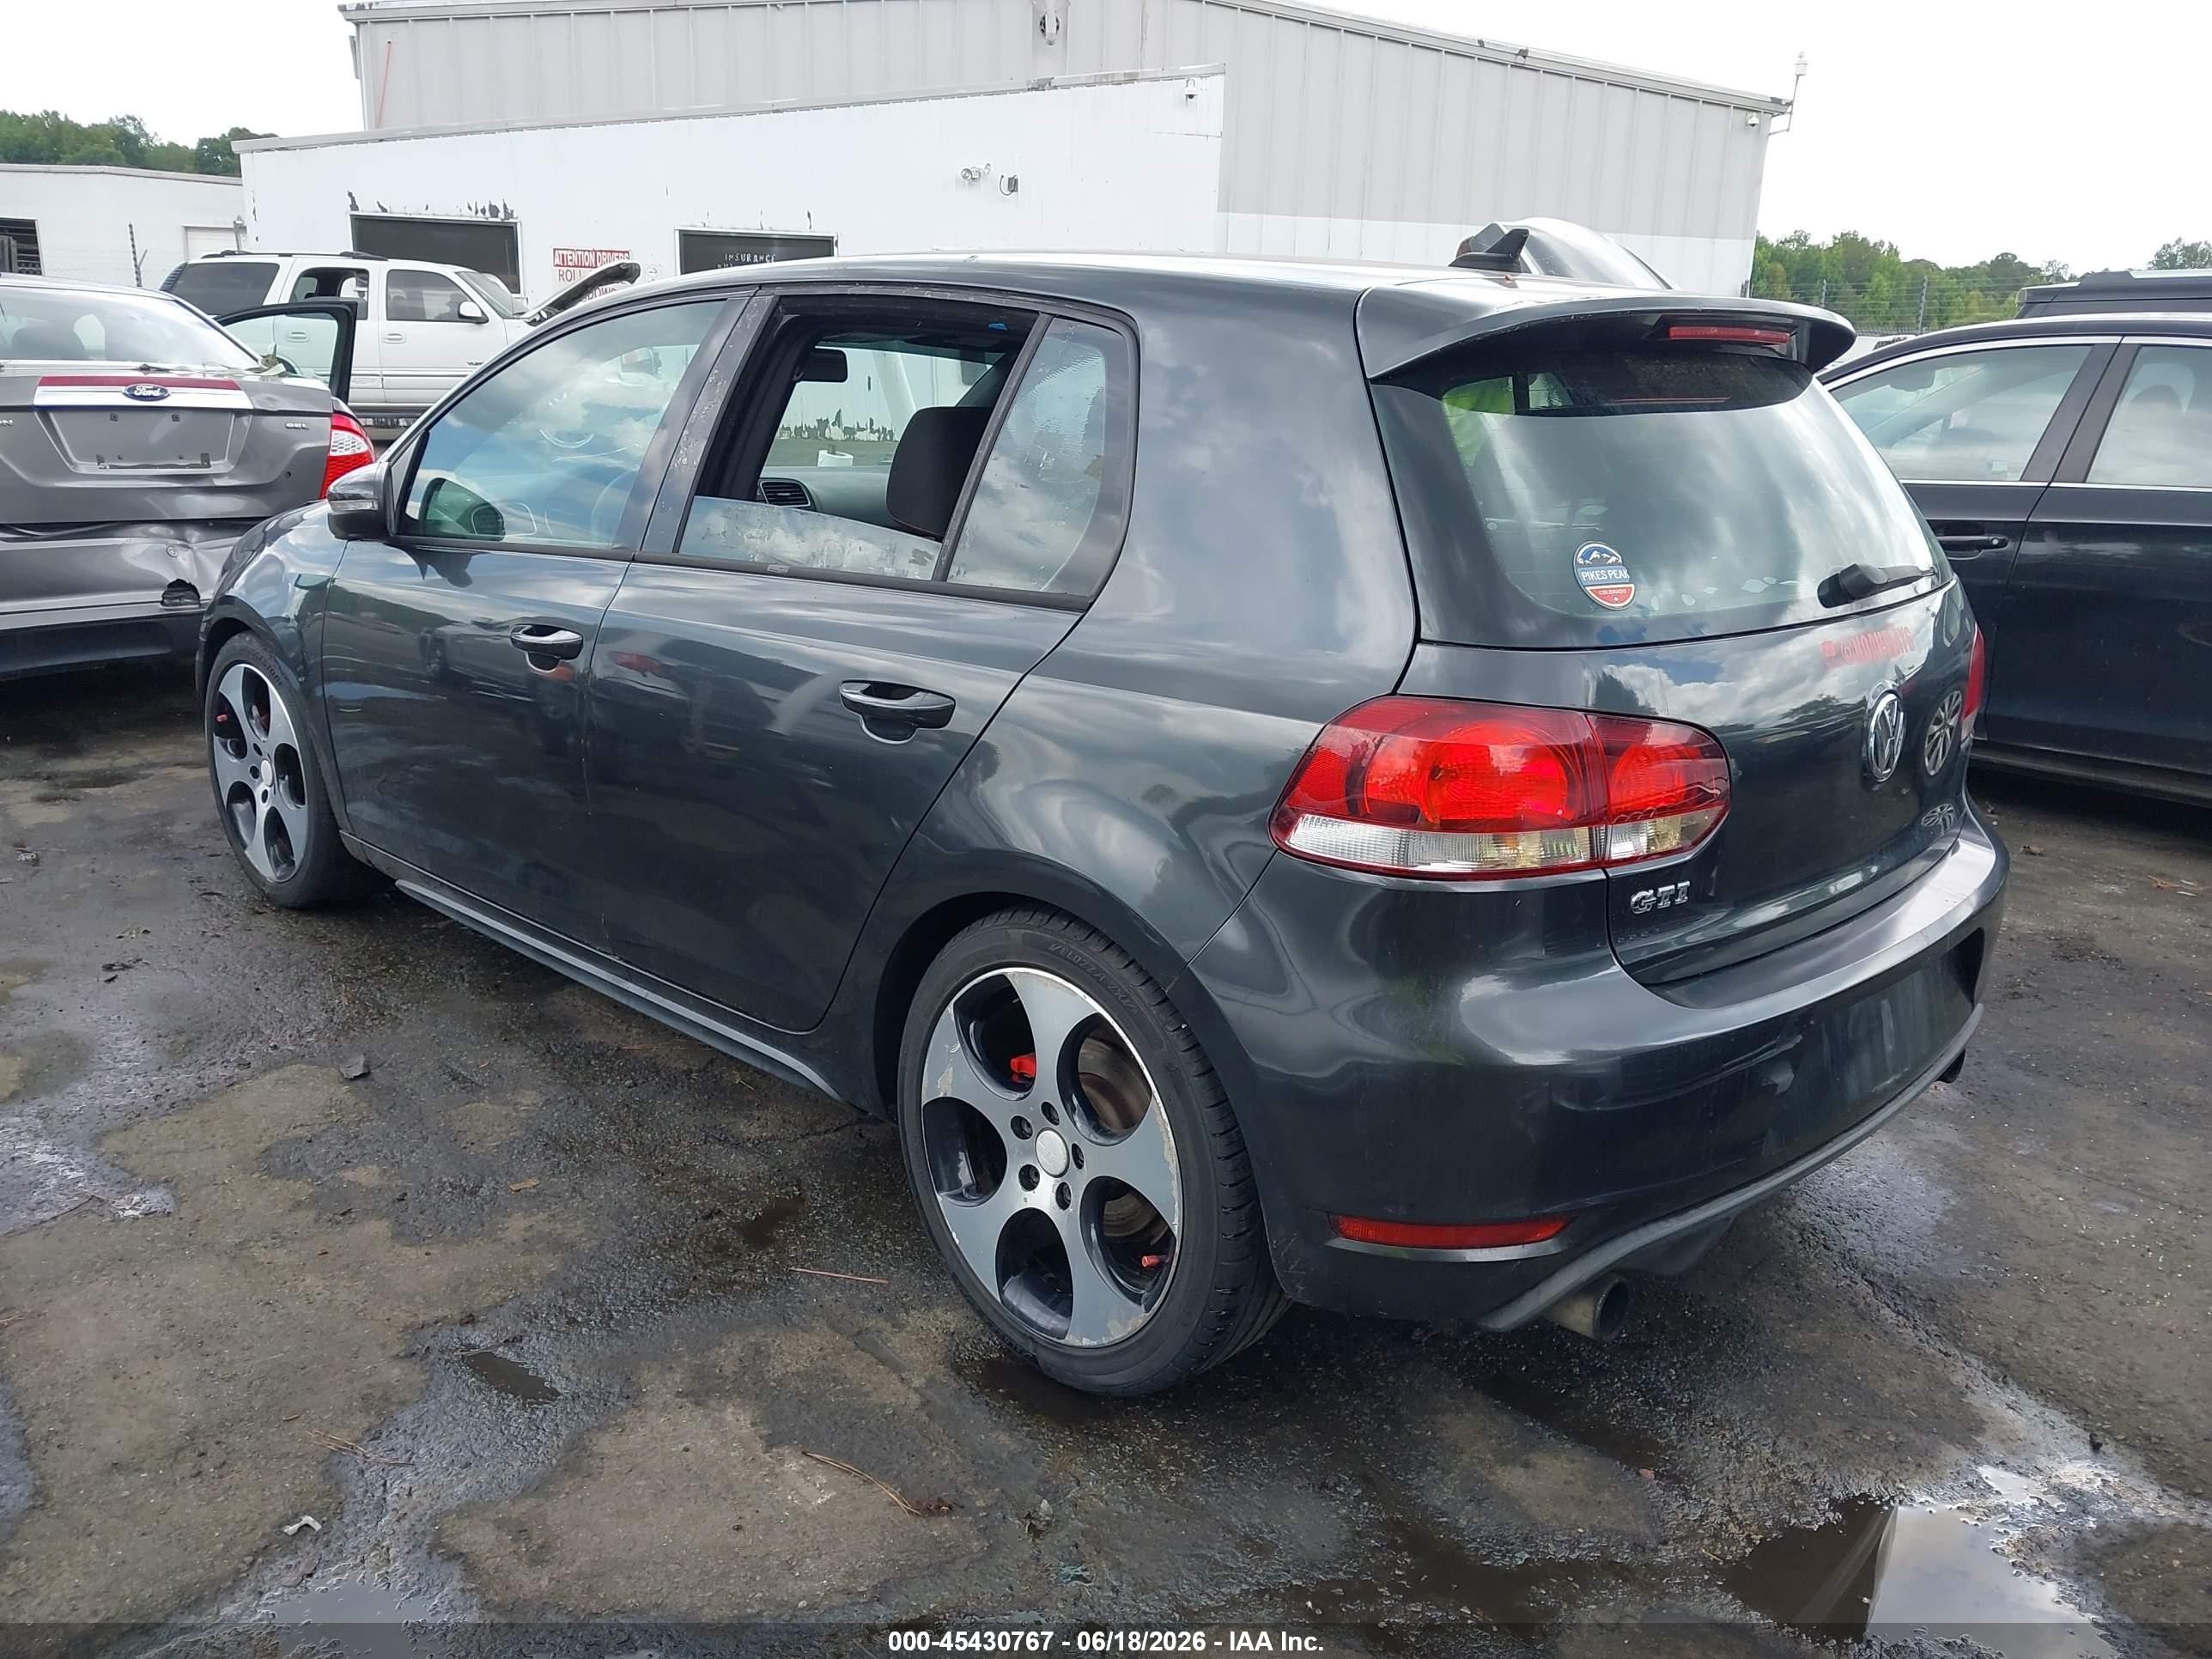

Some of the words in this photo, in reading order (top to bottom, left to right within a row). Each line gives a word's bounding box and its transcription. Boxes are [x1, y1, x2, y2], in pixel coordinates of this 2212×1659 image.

[554, 249, 595, 267] ATTENTION
[725, 252, 776, 263] INSURANCE
[1581, 570, 1607, 581] PIKES
[1631, 880, 1691, 915] GTI
